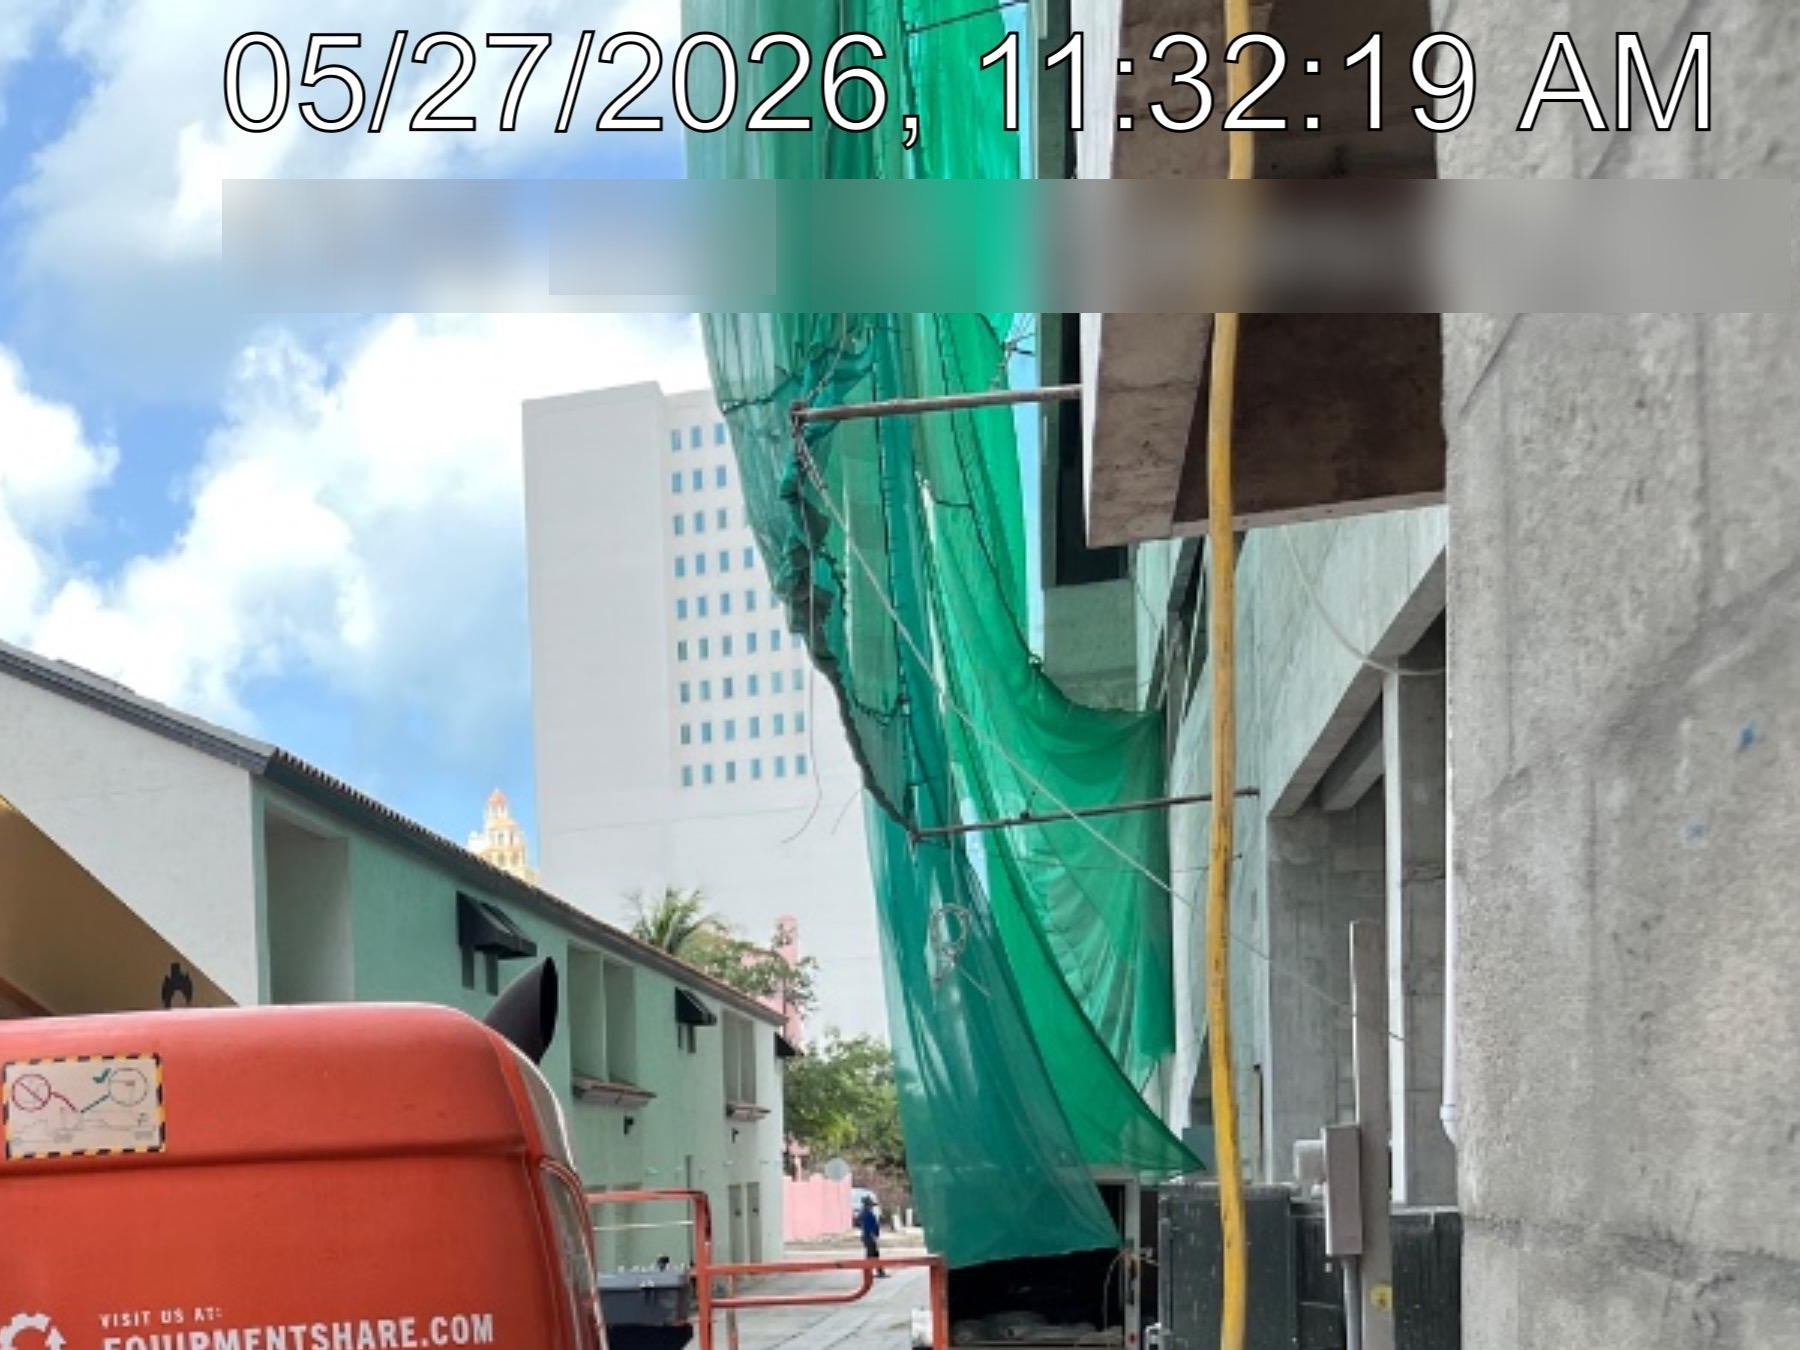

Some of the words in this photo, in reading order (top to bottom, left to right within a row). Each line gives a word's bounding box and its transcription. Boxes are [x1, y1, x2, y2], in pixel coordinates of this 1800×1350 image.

[99, 1311, 150, 1329] VISIT
[161, 1308, 184, 1324] US
[194, 1306, 223, 1323] AT:
